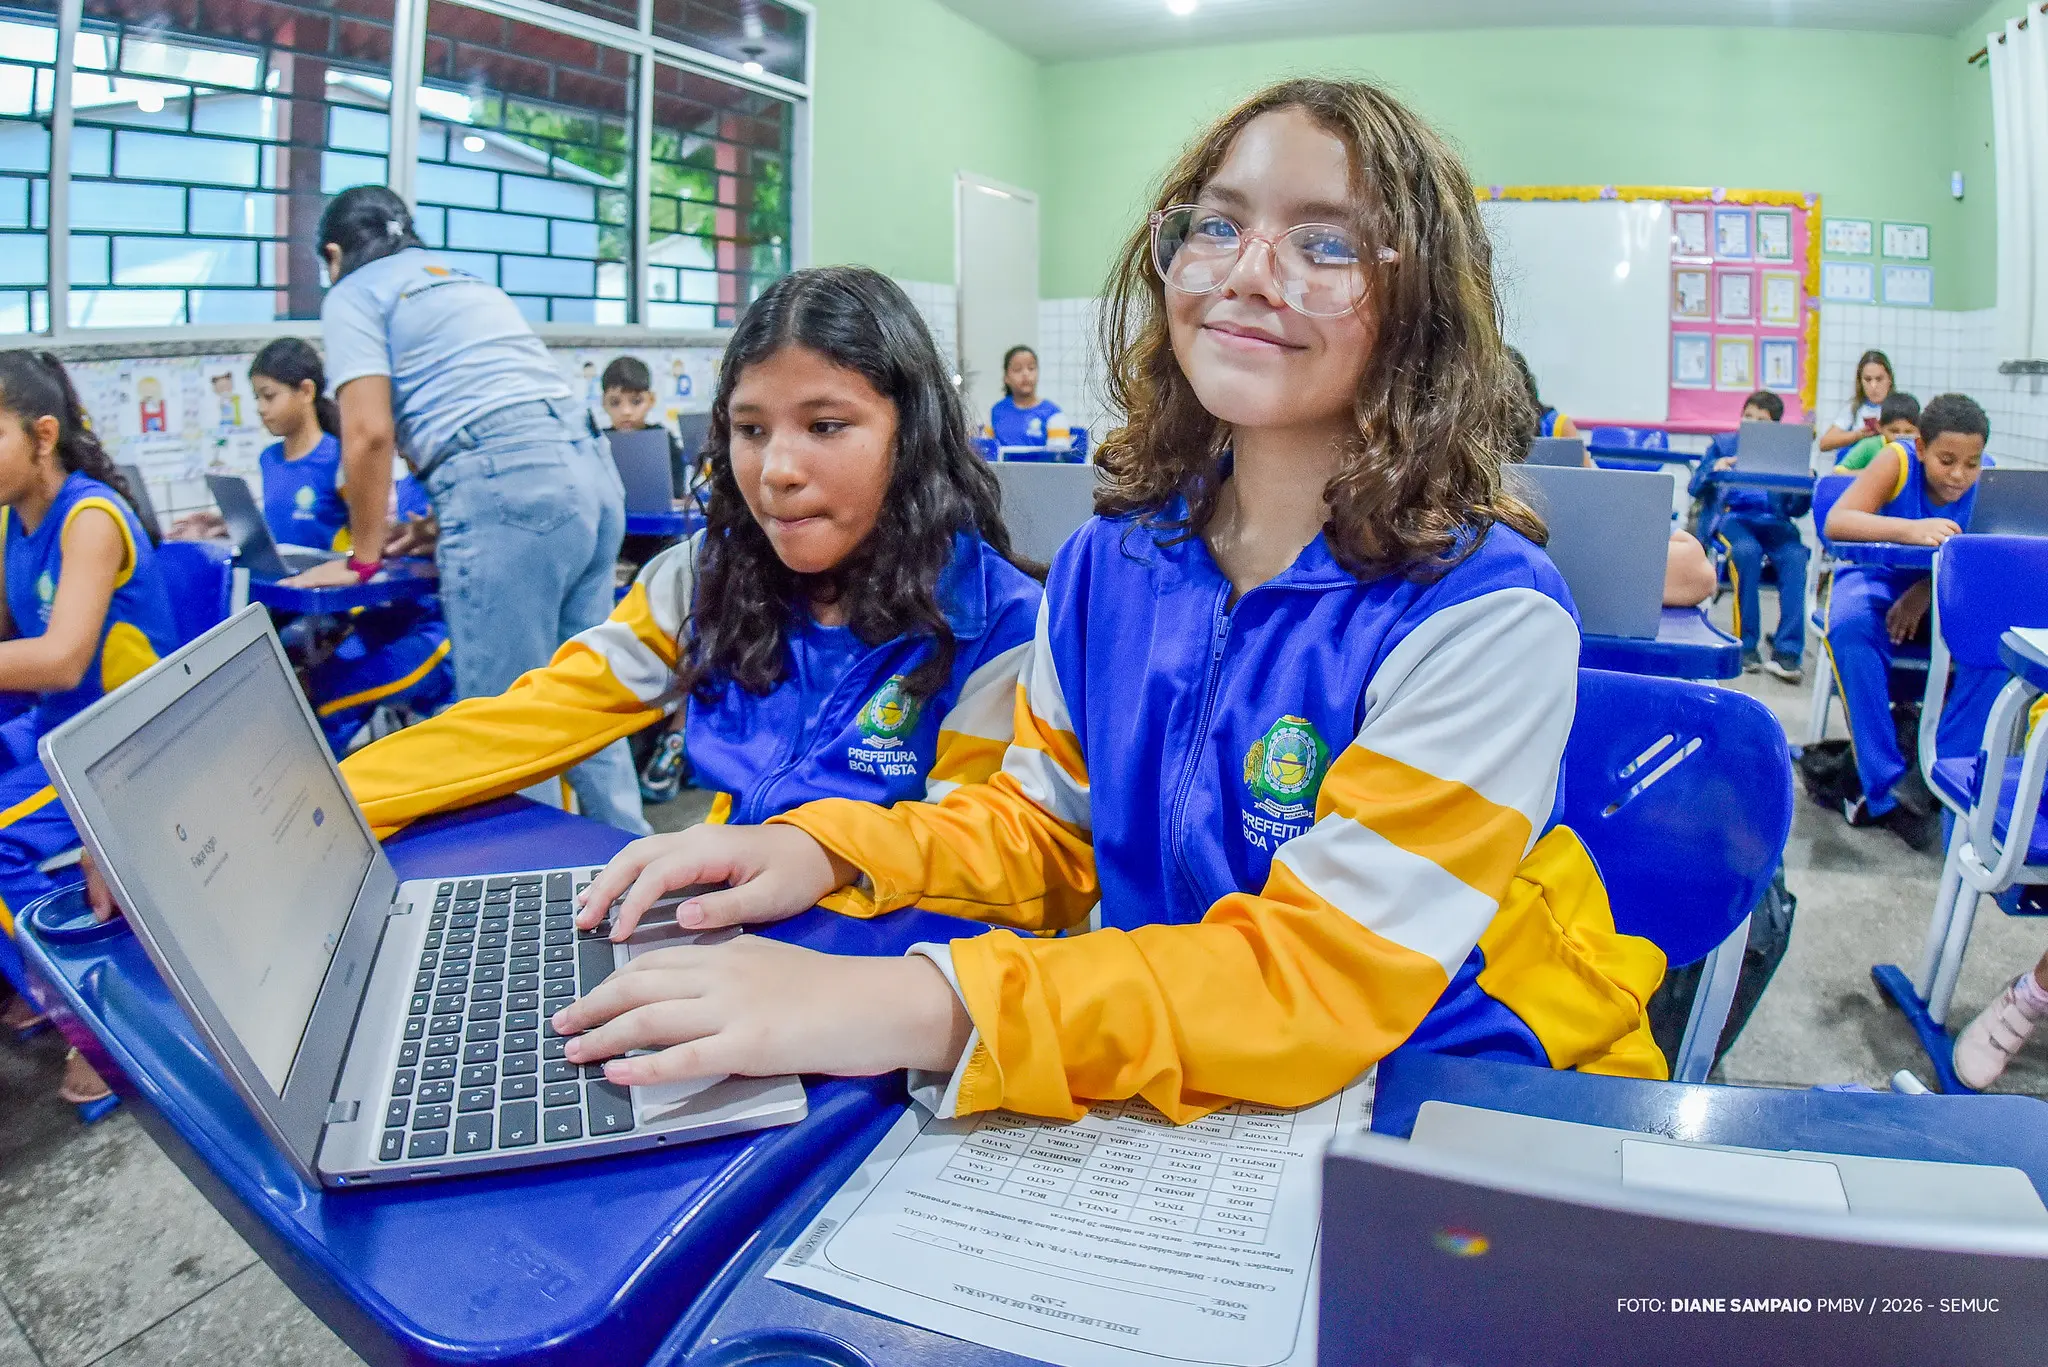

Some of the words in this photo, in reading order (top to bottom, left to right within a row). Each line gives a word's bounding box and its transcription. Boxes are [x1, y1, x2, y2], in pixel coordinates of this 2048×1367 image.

[848, 747, 917, 762] PREFEITURA
[849, 760, 876, 775] BOA
[880, 764, 917, 775] VISTA
[1243, 825, 1268, 851] BOA
[1185, 1122, 1221, 1134] BINATO
[1245, 1120, 1281, 1129] VAPINO
[982, 1124, 1026, 1139] GALINHA
[1040, 1123, 1097, 1140] BEIJA-FLOR
[980, 1138, 1013, 1150] NAVIO
[1046, 1138, 1080, 1149] COBRA
[1108, 1137, 1150, 1149] GUARDA
[969, 1148, 1009, 1162] GUERRA
[1029, 1149, 1082, 1164] BOMBEIRO
[1105, 1149, 1142, 1161] GIRAFA
[1167, 1147, 1212, 1159] QUINTAL
[1268, 1149, 1304, 1158] Palavras
[968, 1161, 993, 1172] CASA
[1031, 1163, 1065, 1174] QUILO
[1098, 1162, 1135, 1174] BARCO
[1167, 1161, 1202, 1171] DENTE
[1227, 1157, 1277, 1169] HOSPITAL
[952, 1173, 990, 1186] CAMPO
[1025, 1175, 1056, 1186] GATO
[1091, 1174, 1130, 1187] QUEIJO
[1160, 1173, 1198, 1184] FOGÃO
[1231, 1170, 1265, 1181] PENTE
[1019, 1188, 1048, 1200] BOLA
[1088, 1189, 1119, 1200] DADO
[1153, 1186, 1196, 1198] HOMEM
[1231, 1184, 1258, 1193] GUIA
[1077, 1201, 1119, 1215] PANELA
[1153, 1200, 1185, 1212] TINTA
[1226, 1197, 1254, 1208] HOJE
[961, 1205, 975, 1213] ler
[1016, 1218, 1034, 1226] não
[1049, 1212, 1087, 1224] palavras
[1148, 1215, 1178, 1226] VASO
[1216, 1211, 1254, 1223] VENTO
[1034, 1222, 1059, 1232] aluno
[1063, 1228, 1084, 1237] que
[1216, 1226, 1247, 1237] FACA
[1084, 1233, 1137, 1248] ortográficas
[1145, 1232, 1160, 1240] ler
[1160, 1235, 1183, 1243] meta
[957, 1242, 985, 1255] DATA
[1138, 1243, 1193, 1258] dificuldades
[1190, 1240, 1228, 1251] verdade
[1241, 1248, 1281, 1260] Palavras
[1092, 1254, 1148, 1269] ortográficas
[1204, 1255, 1240, 1268] Marque
[1148, 1264, 1205, 1281] Dificuldades
[1242, 1261, 1295, 1275] Instruções:
[1220, 1277, 1276, 1293] CADERNO
[952, 1283, 1009, 1305] PALAVRAS
[1029, 1293, 1055, 1305] ANO
[1009, 1299, 1026, 1310] DE
[1210, 1297, 1248, 1311] NOME:
[1026, 1303, 1077, 1322] LEITURA
[1196, 1306, 1247, 1322] ESCOLA:
[1077, 1315, 1094, 1326] DE
[1103, 1321, 1140, 1336] TESTE
